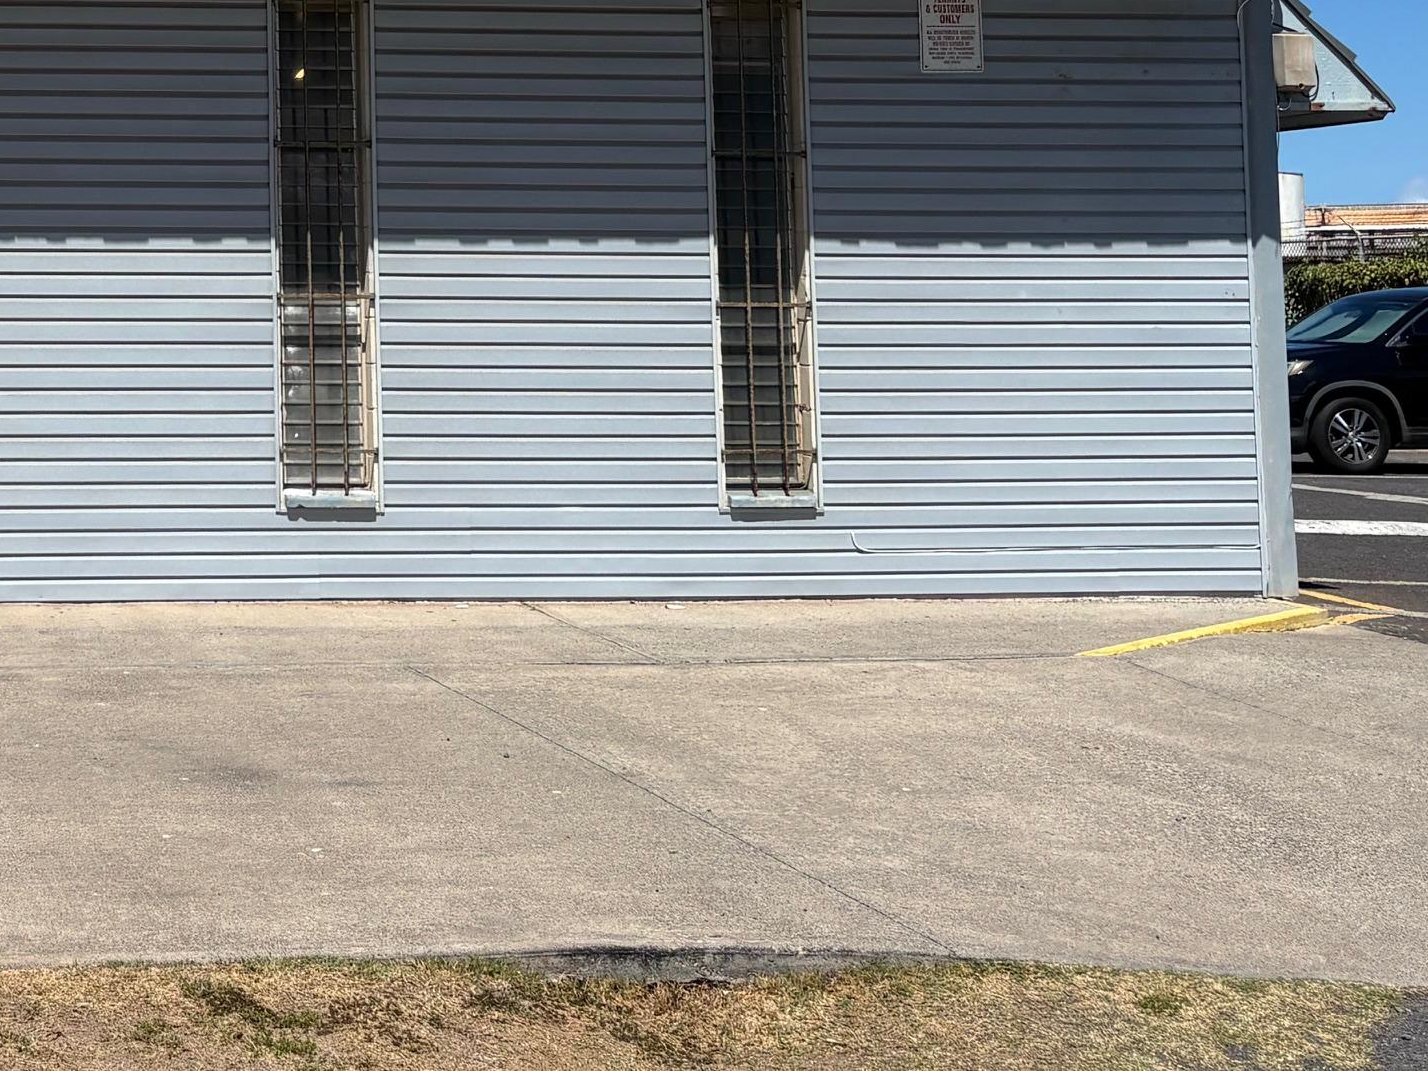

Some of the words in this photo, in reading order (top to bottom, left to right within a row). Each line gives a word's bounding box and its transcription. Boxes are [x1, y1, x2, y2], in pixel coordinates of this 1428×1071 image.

[925, 5, 931, 13] &
[933, 5, 974, 13] CUSTOMERS
[939, 15, 961, 24] ONLY
